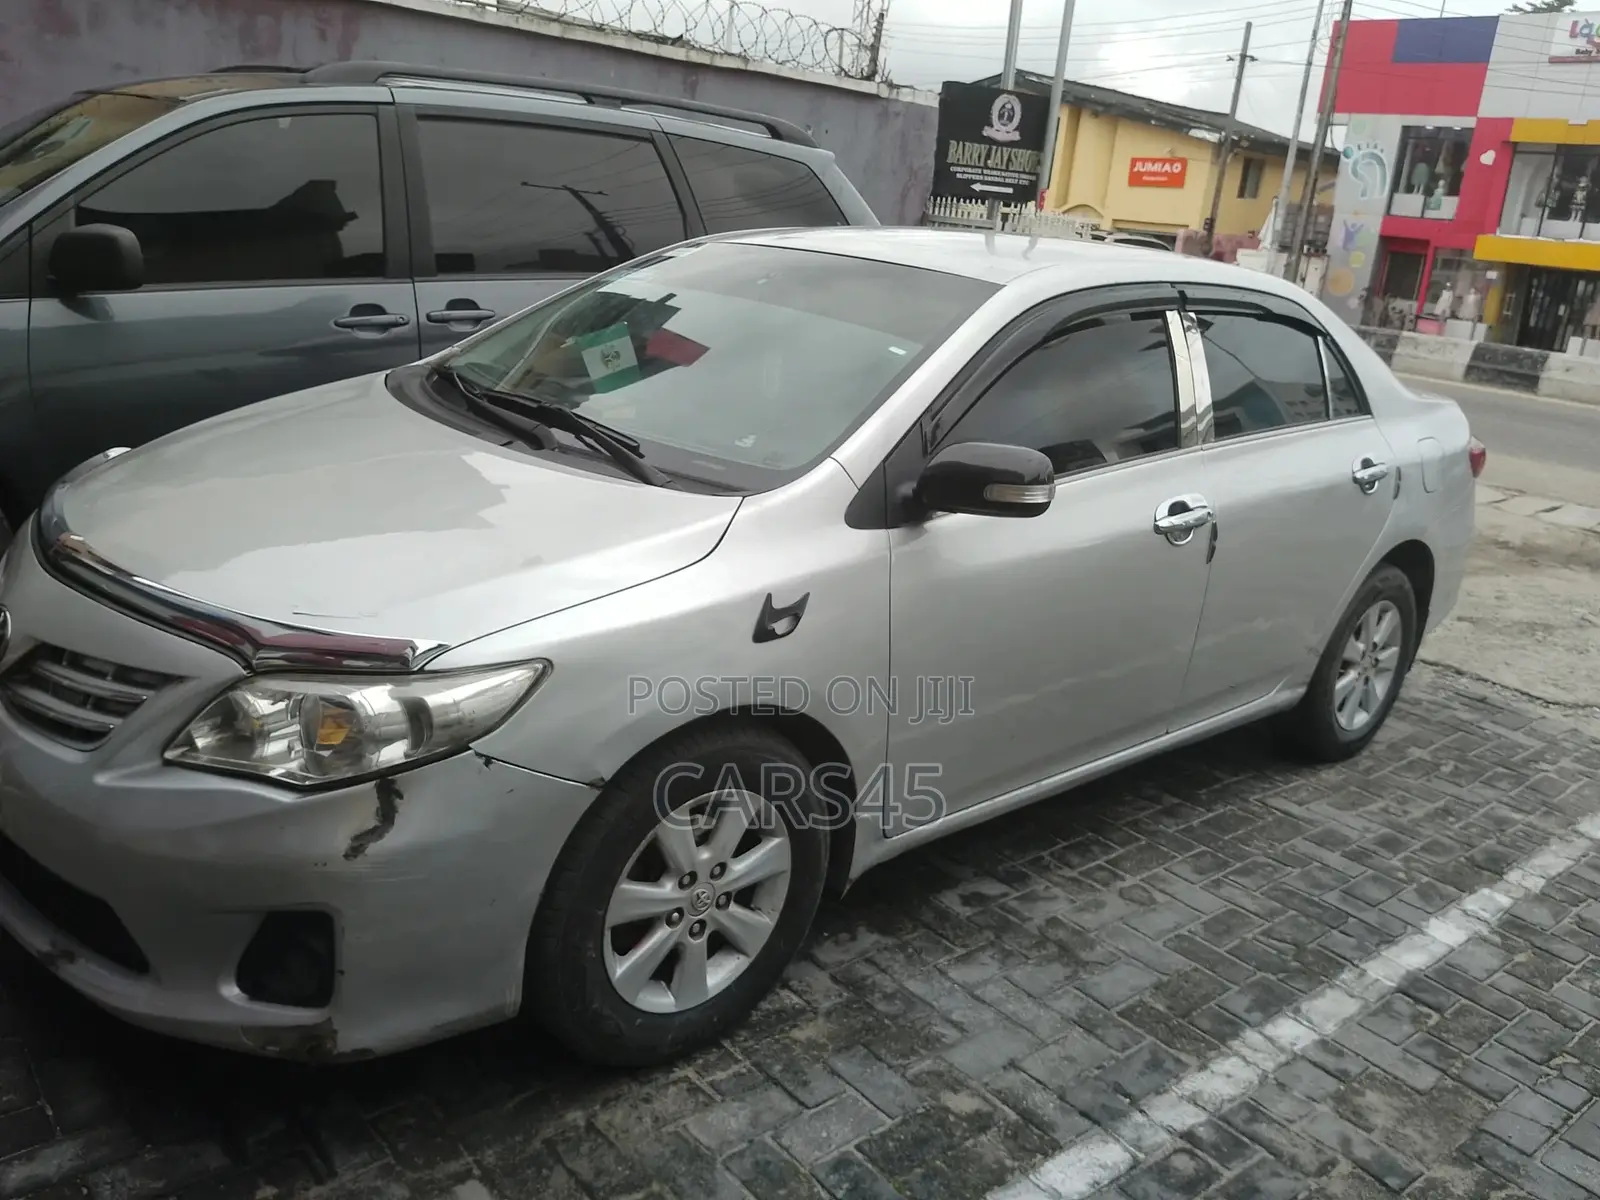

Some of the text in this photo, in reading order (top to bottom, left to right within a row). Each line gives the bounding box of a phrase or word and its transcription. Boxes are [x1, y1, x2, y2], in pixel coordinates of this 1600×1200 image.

[946, 139, 989, 166] BARRY
[987, 145, 1011, 168] JAY
[1133, 161, 1172, 173] JUMIA
